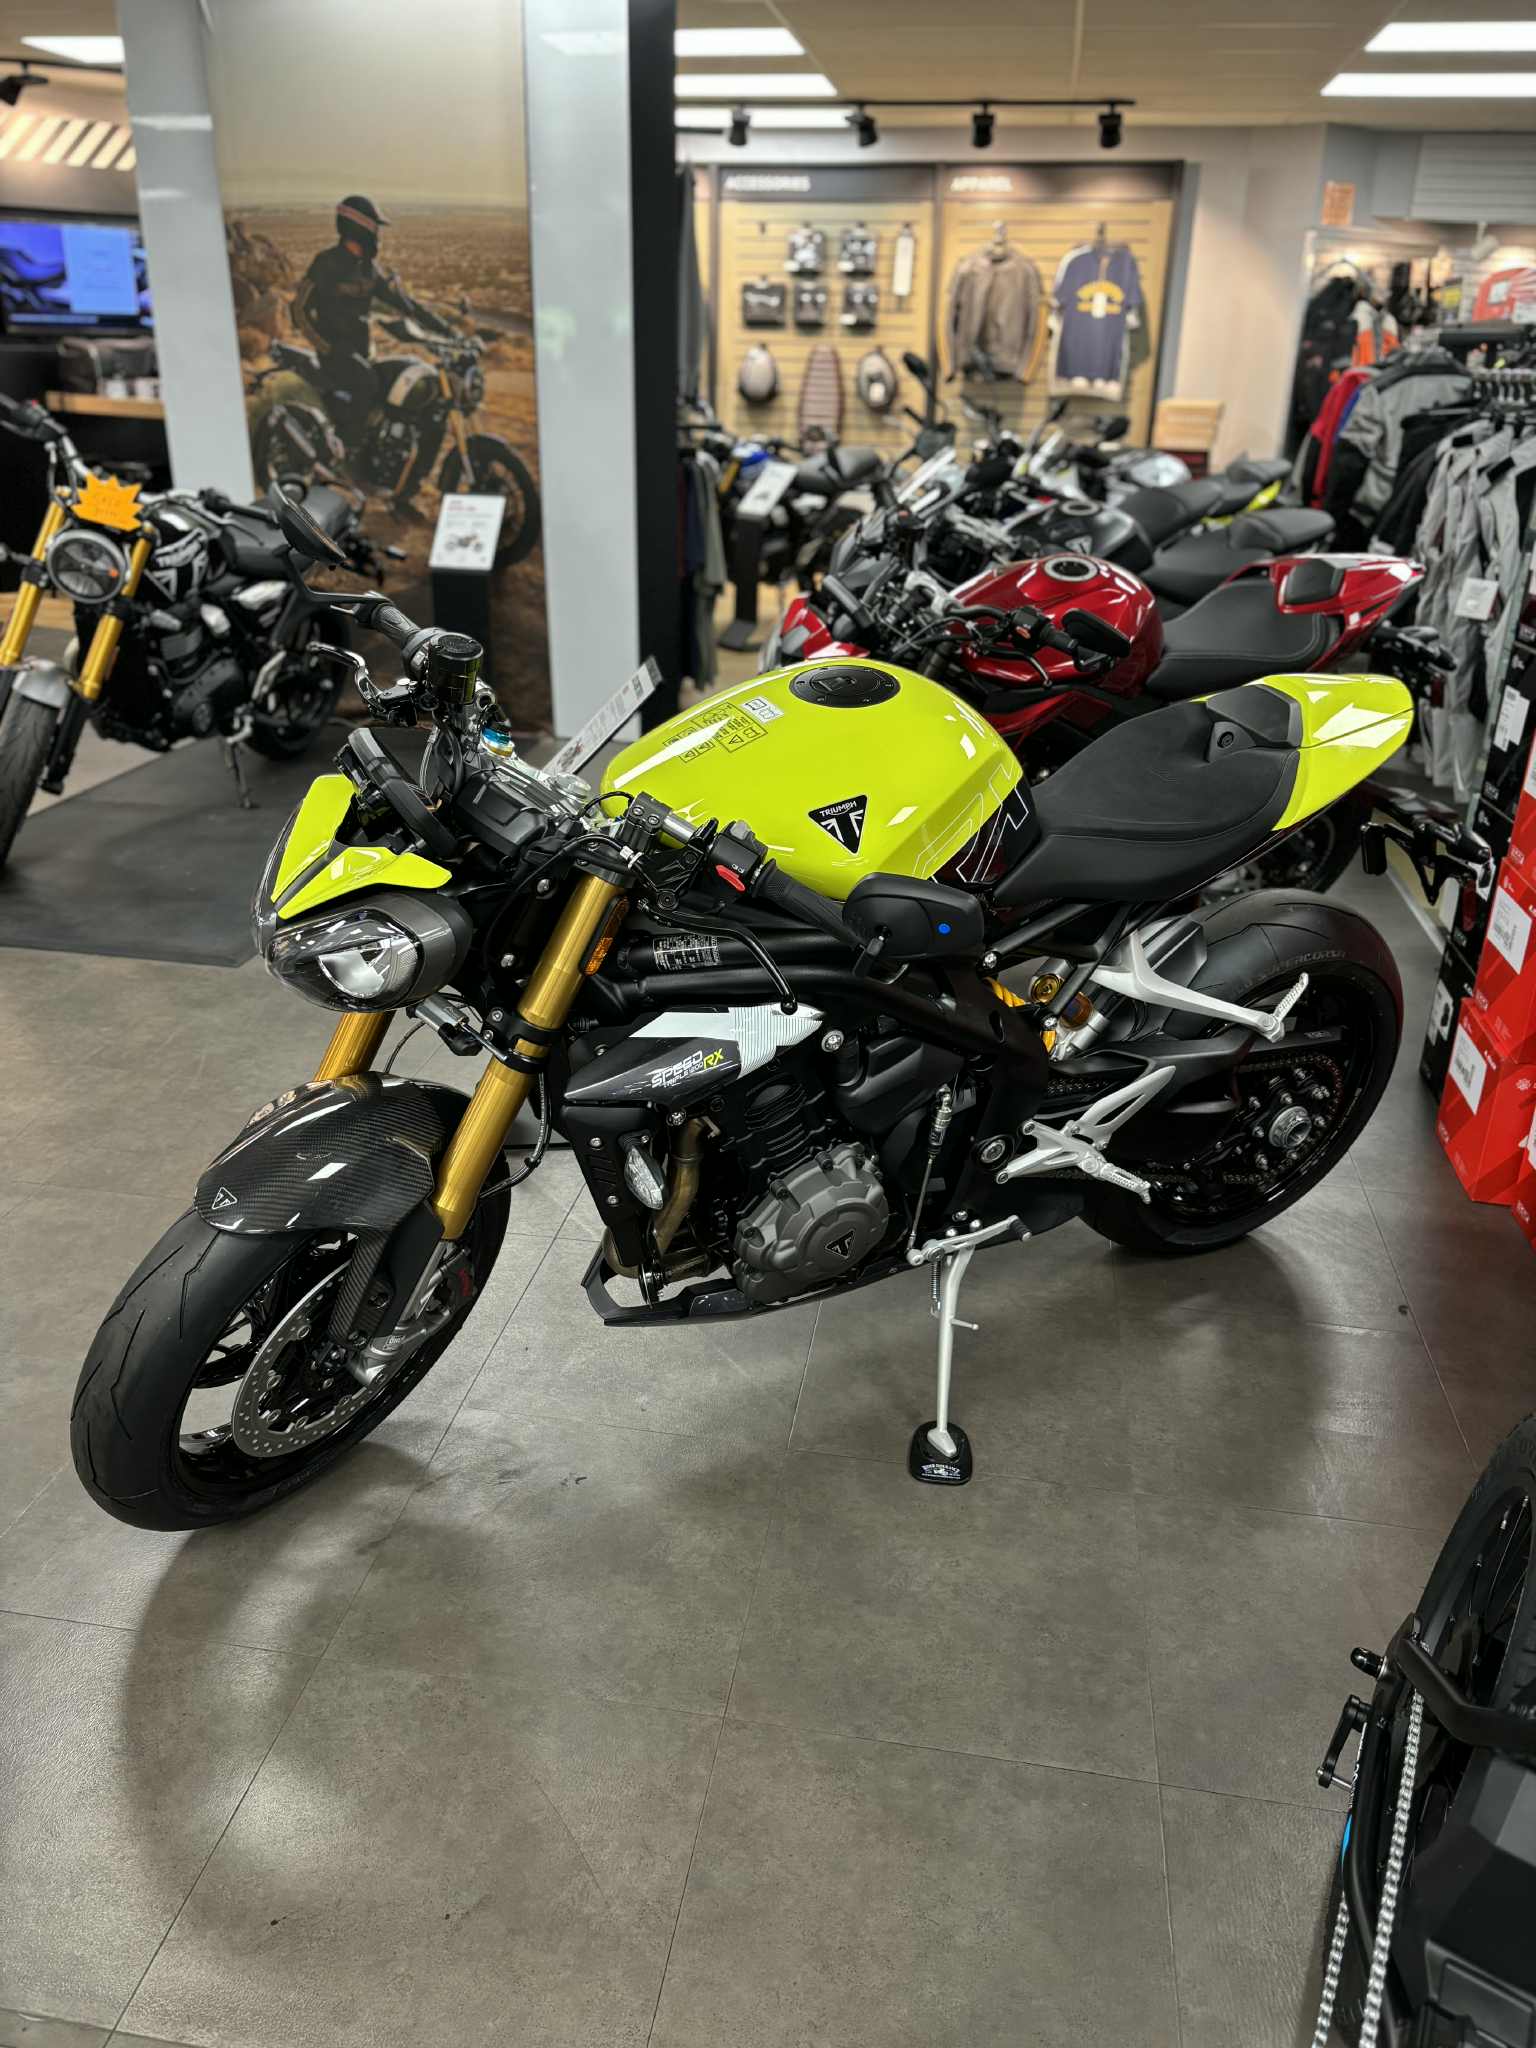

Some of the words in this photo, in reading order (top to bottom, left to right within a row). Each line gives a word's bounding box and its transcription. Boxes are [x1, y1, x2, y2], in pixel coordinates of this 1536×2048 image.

[819, 800, 857, 817] TRIUMPH
[651, 1049, 703, 1088] SPEED
[703, 1047, 724, 1070] RX
